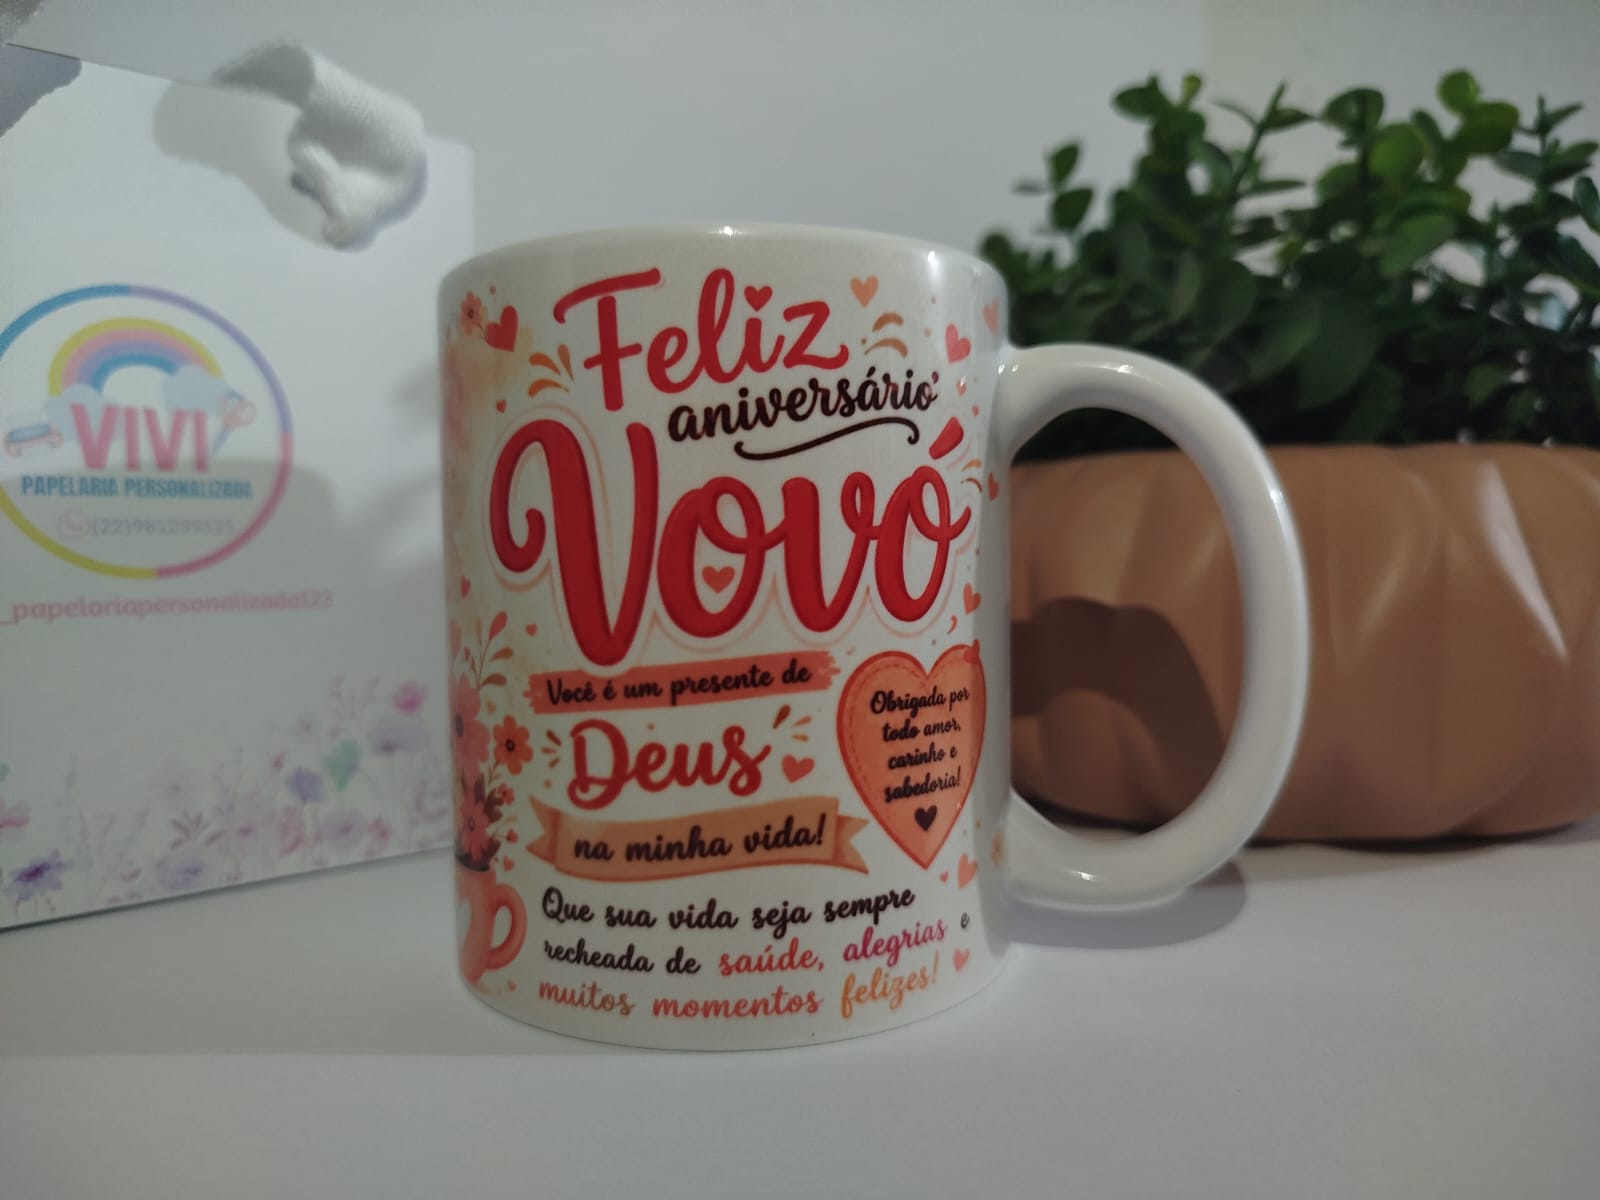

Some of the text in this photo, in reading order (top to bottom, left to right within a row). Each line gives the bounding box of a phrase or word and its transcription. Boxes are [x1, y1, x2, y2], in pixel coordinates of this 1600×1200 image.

[553, 267, 849, 411] Feliz
[70, 403, 210, 472] VIVI
[21, 474, 119, 497] PAPELARIA
[489, 416, 972, 667] Vovó
[546, 659, 812, 705] Você é um presente de
[870, 685, 969, 718] Obrigada por
[882, 717, 961, 742] todo amor,
[567, 719, 771, 811] Deus
[888, 742, 957, 770] carinho e
[884, 765, 961, 803] sabedoria!
[574, 813, 826, 863] na minha vida!
[542, 887, 915, 939] Que sua vida seja sempre
[544, 912, 969, 977] recheada de saúde, alegrias e
[539, 952, 939, 1020] muitos momentos felizes!
